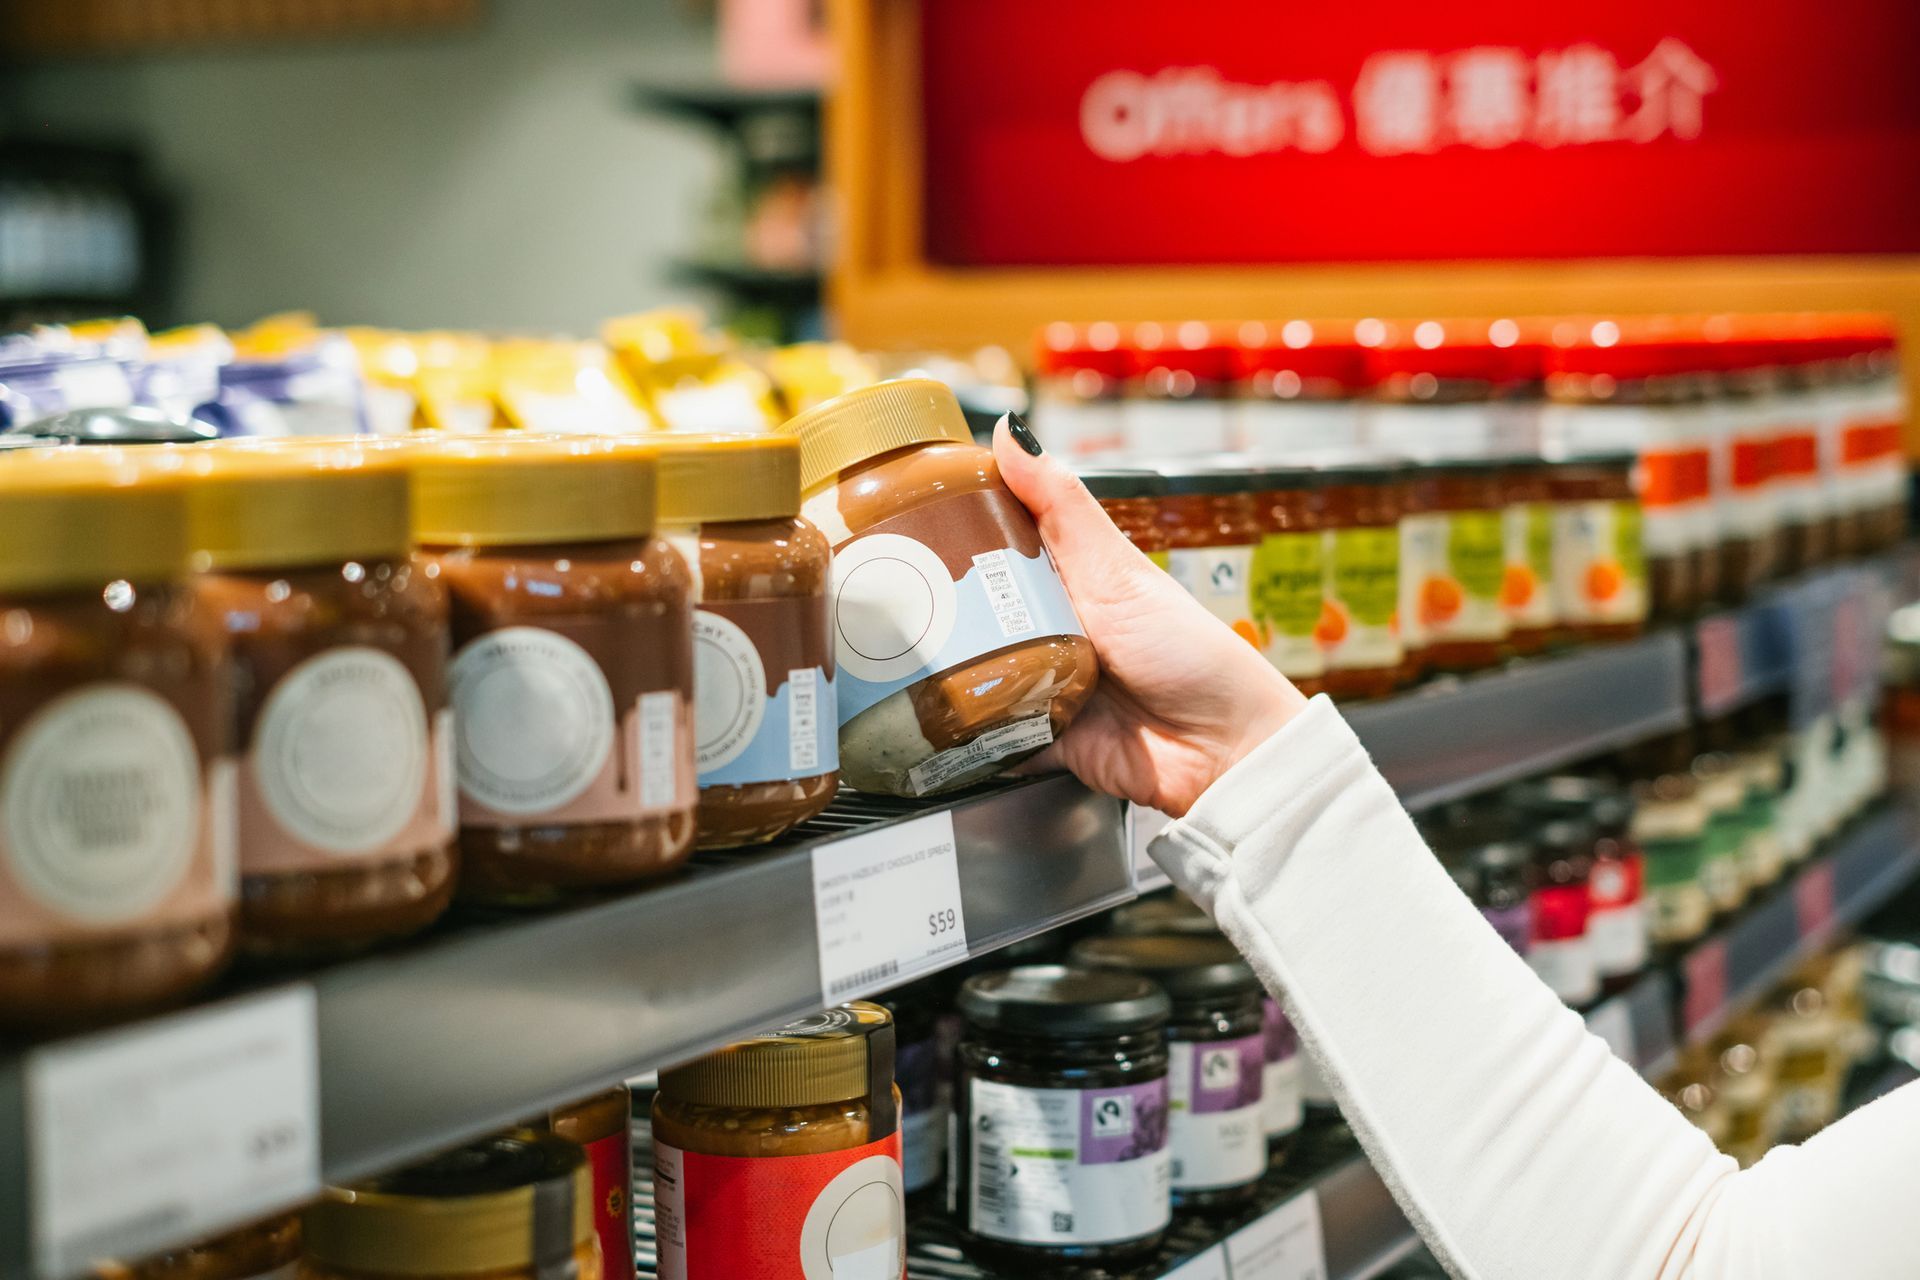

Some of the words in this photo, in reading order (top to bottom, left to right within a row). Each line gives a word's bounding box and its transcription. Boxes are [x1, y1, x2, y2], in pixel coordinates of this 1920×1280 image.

[1080, 67, 1343, 160] Offers
[985, 570, 1007, 580] Energy
[887, 850, 926, 870] CHOCOLATE
[927, 842, 952, 859] SPREAD
[928, 908, 956, 936] $59
